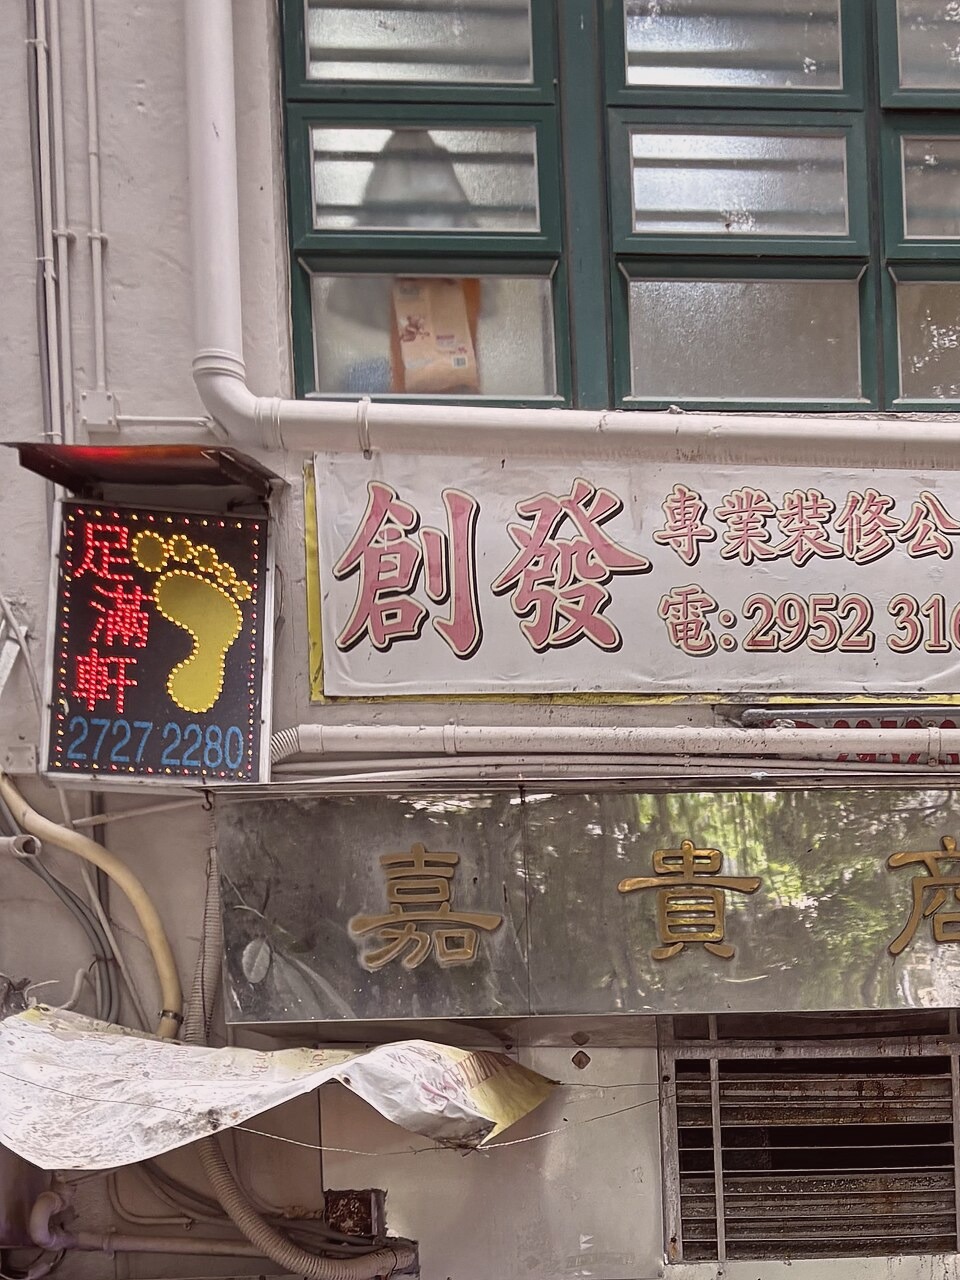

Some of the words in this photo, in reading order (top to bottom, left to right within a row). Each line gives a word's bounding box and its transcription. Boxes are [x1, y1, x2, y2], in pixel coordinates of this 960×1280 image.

[72, 521, 155, 714] 足滿軒
[333, 477, 652, 659] 創發
[66, 715, 153, 762] 2727
[160, 721, 244, 770] 2280
